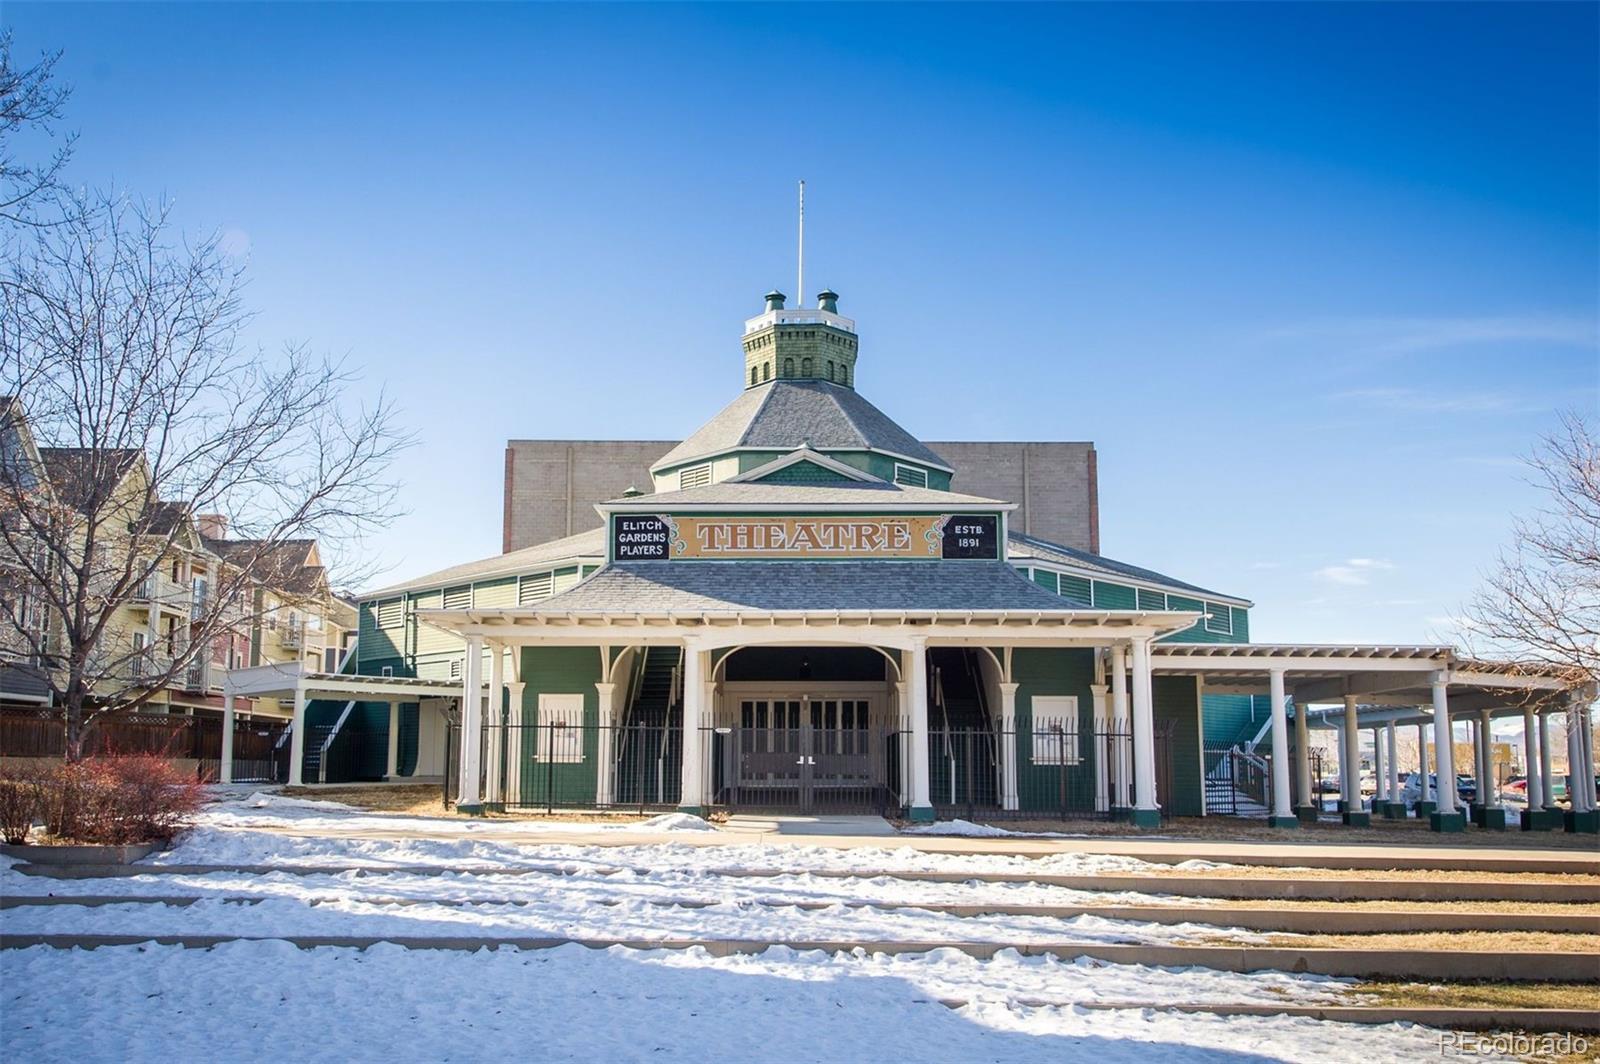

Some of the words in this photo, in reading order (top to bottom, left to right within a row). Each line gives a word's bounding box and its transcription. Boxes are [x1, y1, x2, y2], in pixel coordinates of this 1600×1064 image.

[623, 521, 662, 530] ELITCH
[955, 525, 985, 534] ESTB.
[619, 533, 666, 542] GARDENS
[697, 522, 912, 552] THEATRE
[959, 538, 980, 547] 1891
[620, 545, 663, 555] PLAYERS
